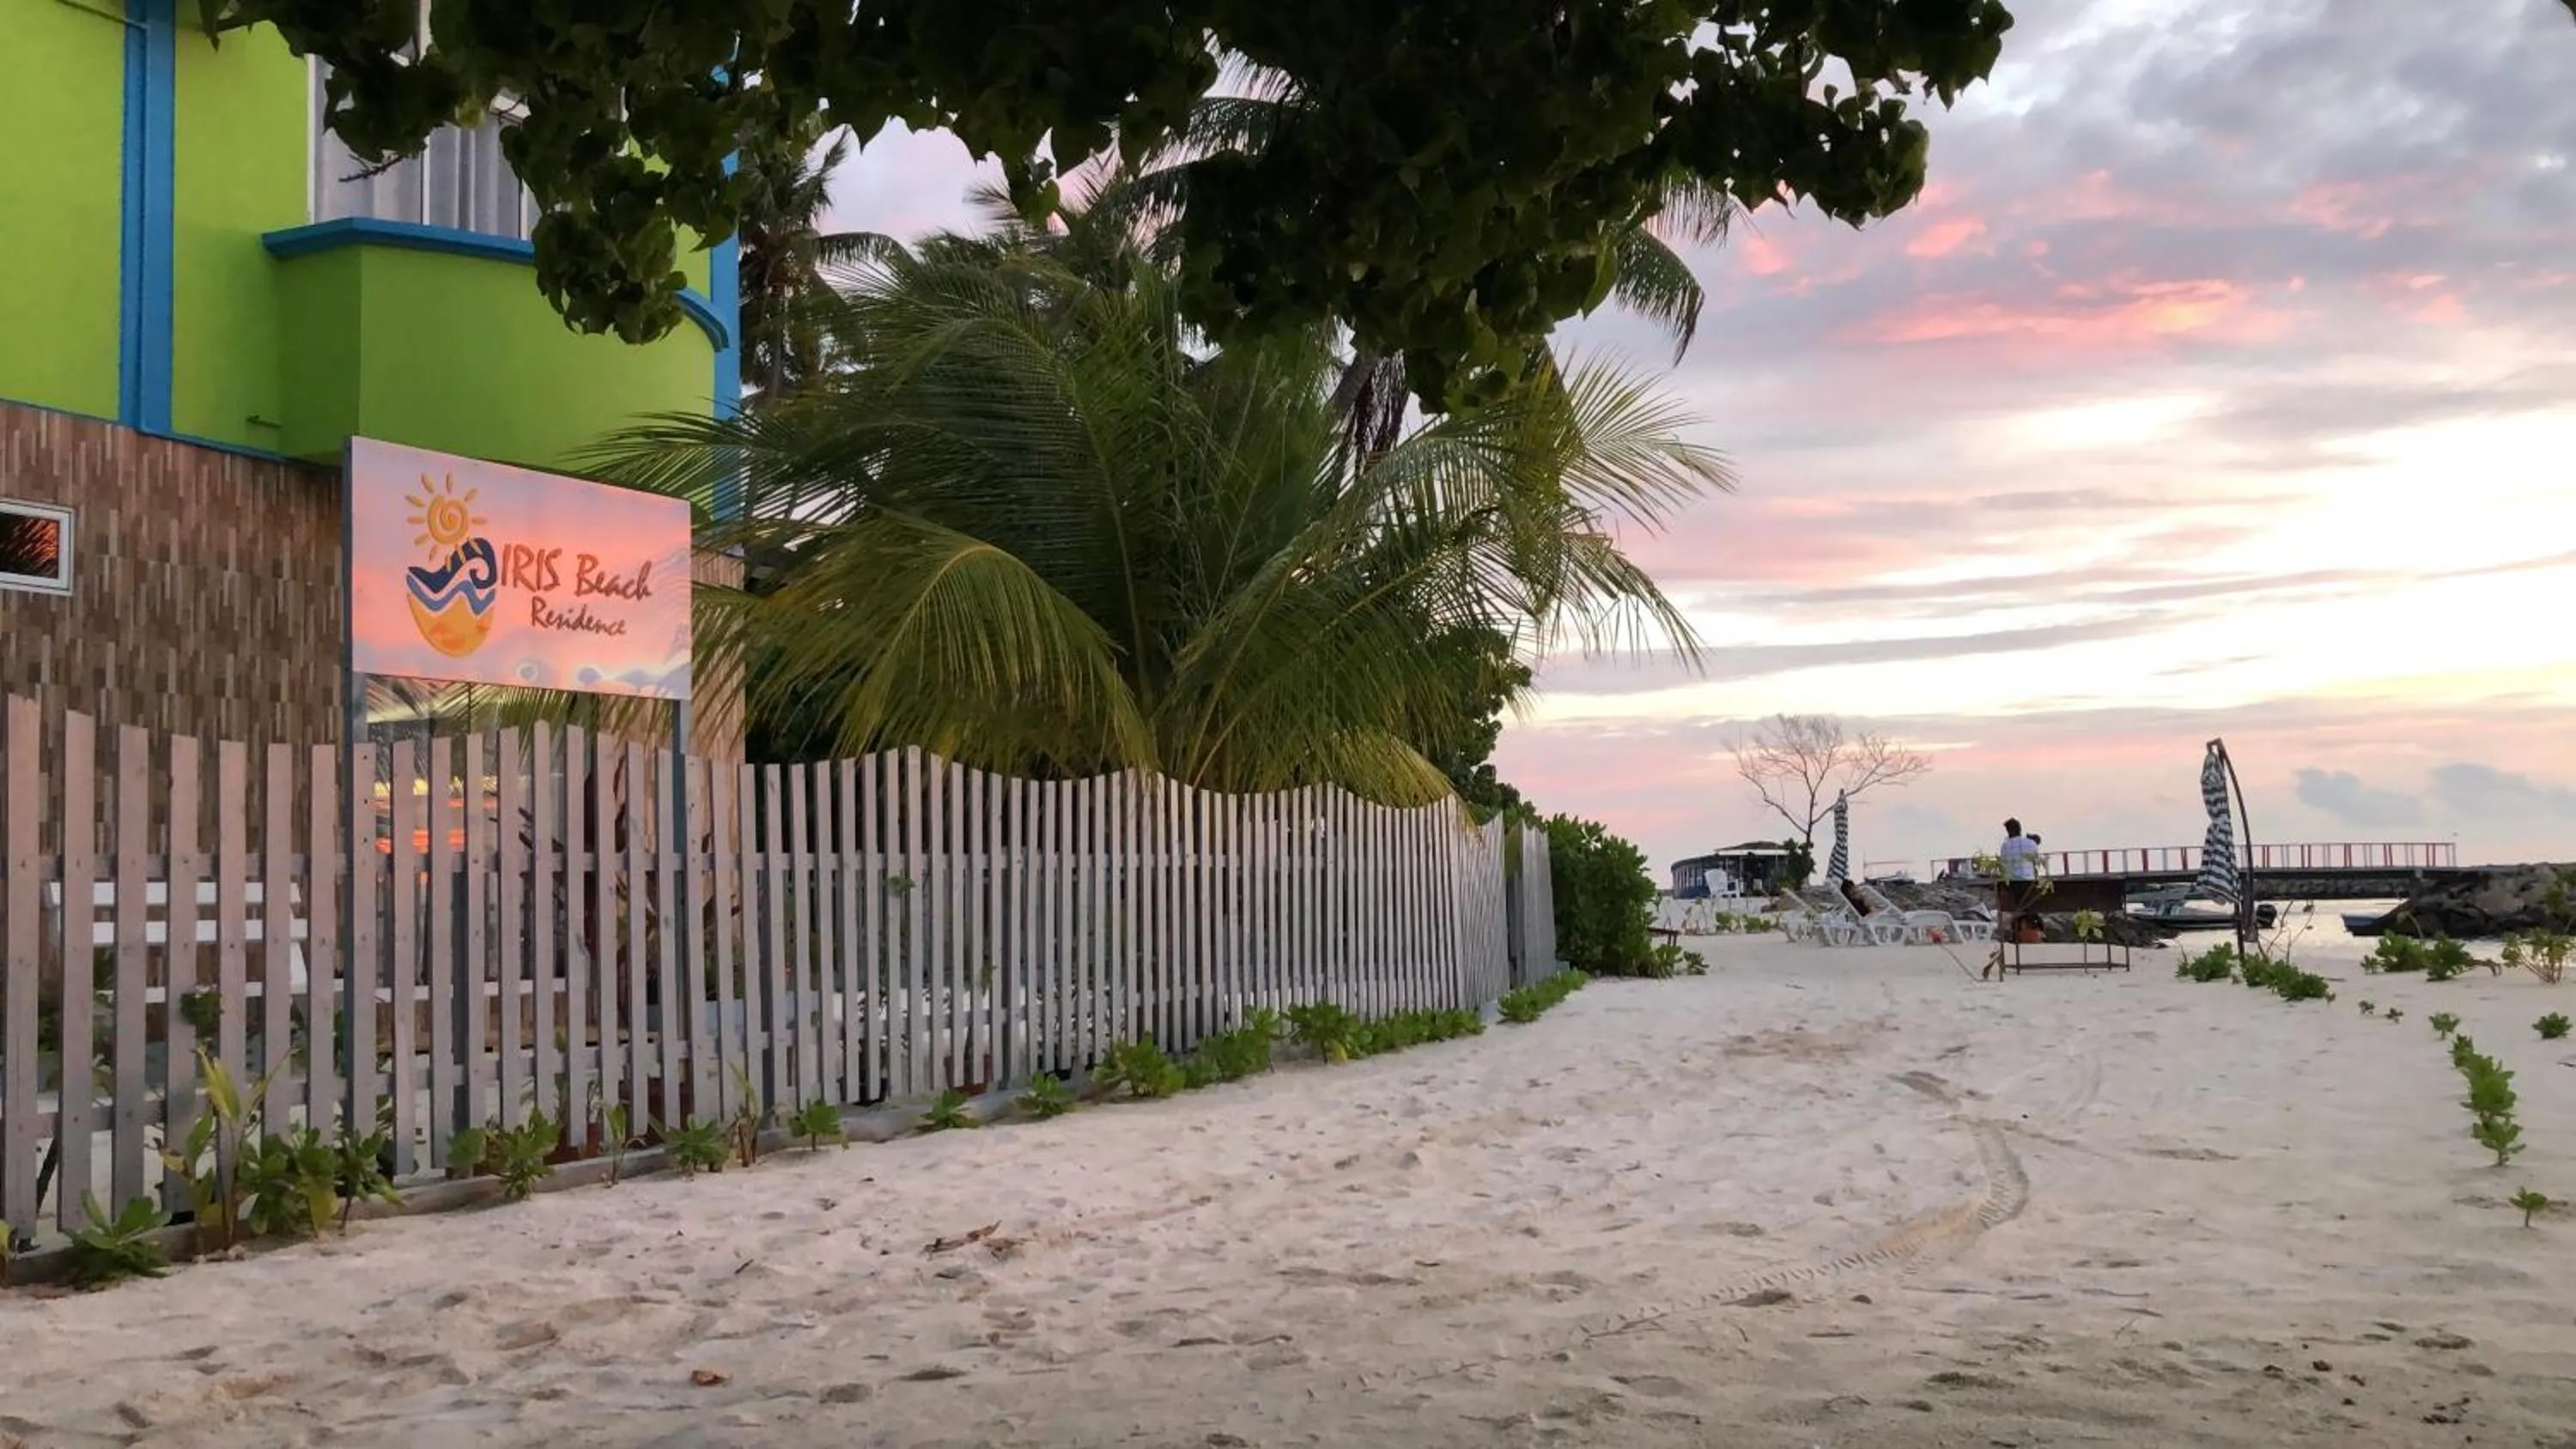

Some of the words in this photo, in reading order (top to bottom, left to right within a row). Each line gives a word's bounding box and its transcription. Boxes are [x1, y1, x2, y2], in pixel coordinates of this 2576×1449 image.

[501, 543, 562, 592] IRIS
[574, 554, 653, 601] Beach
[531, 595, 626, 636] Residence
